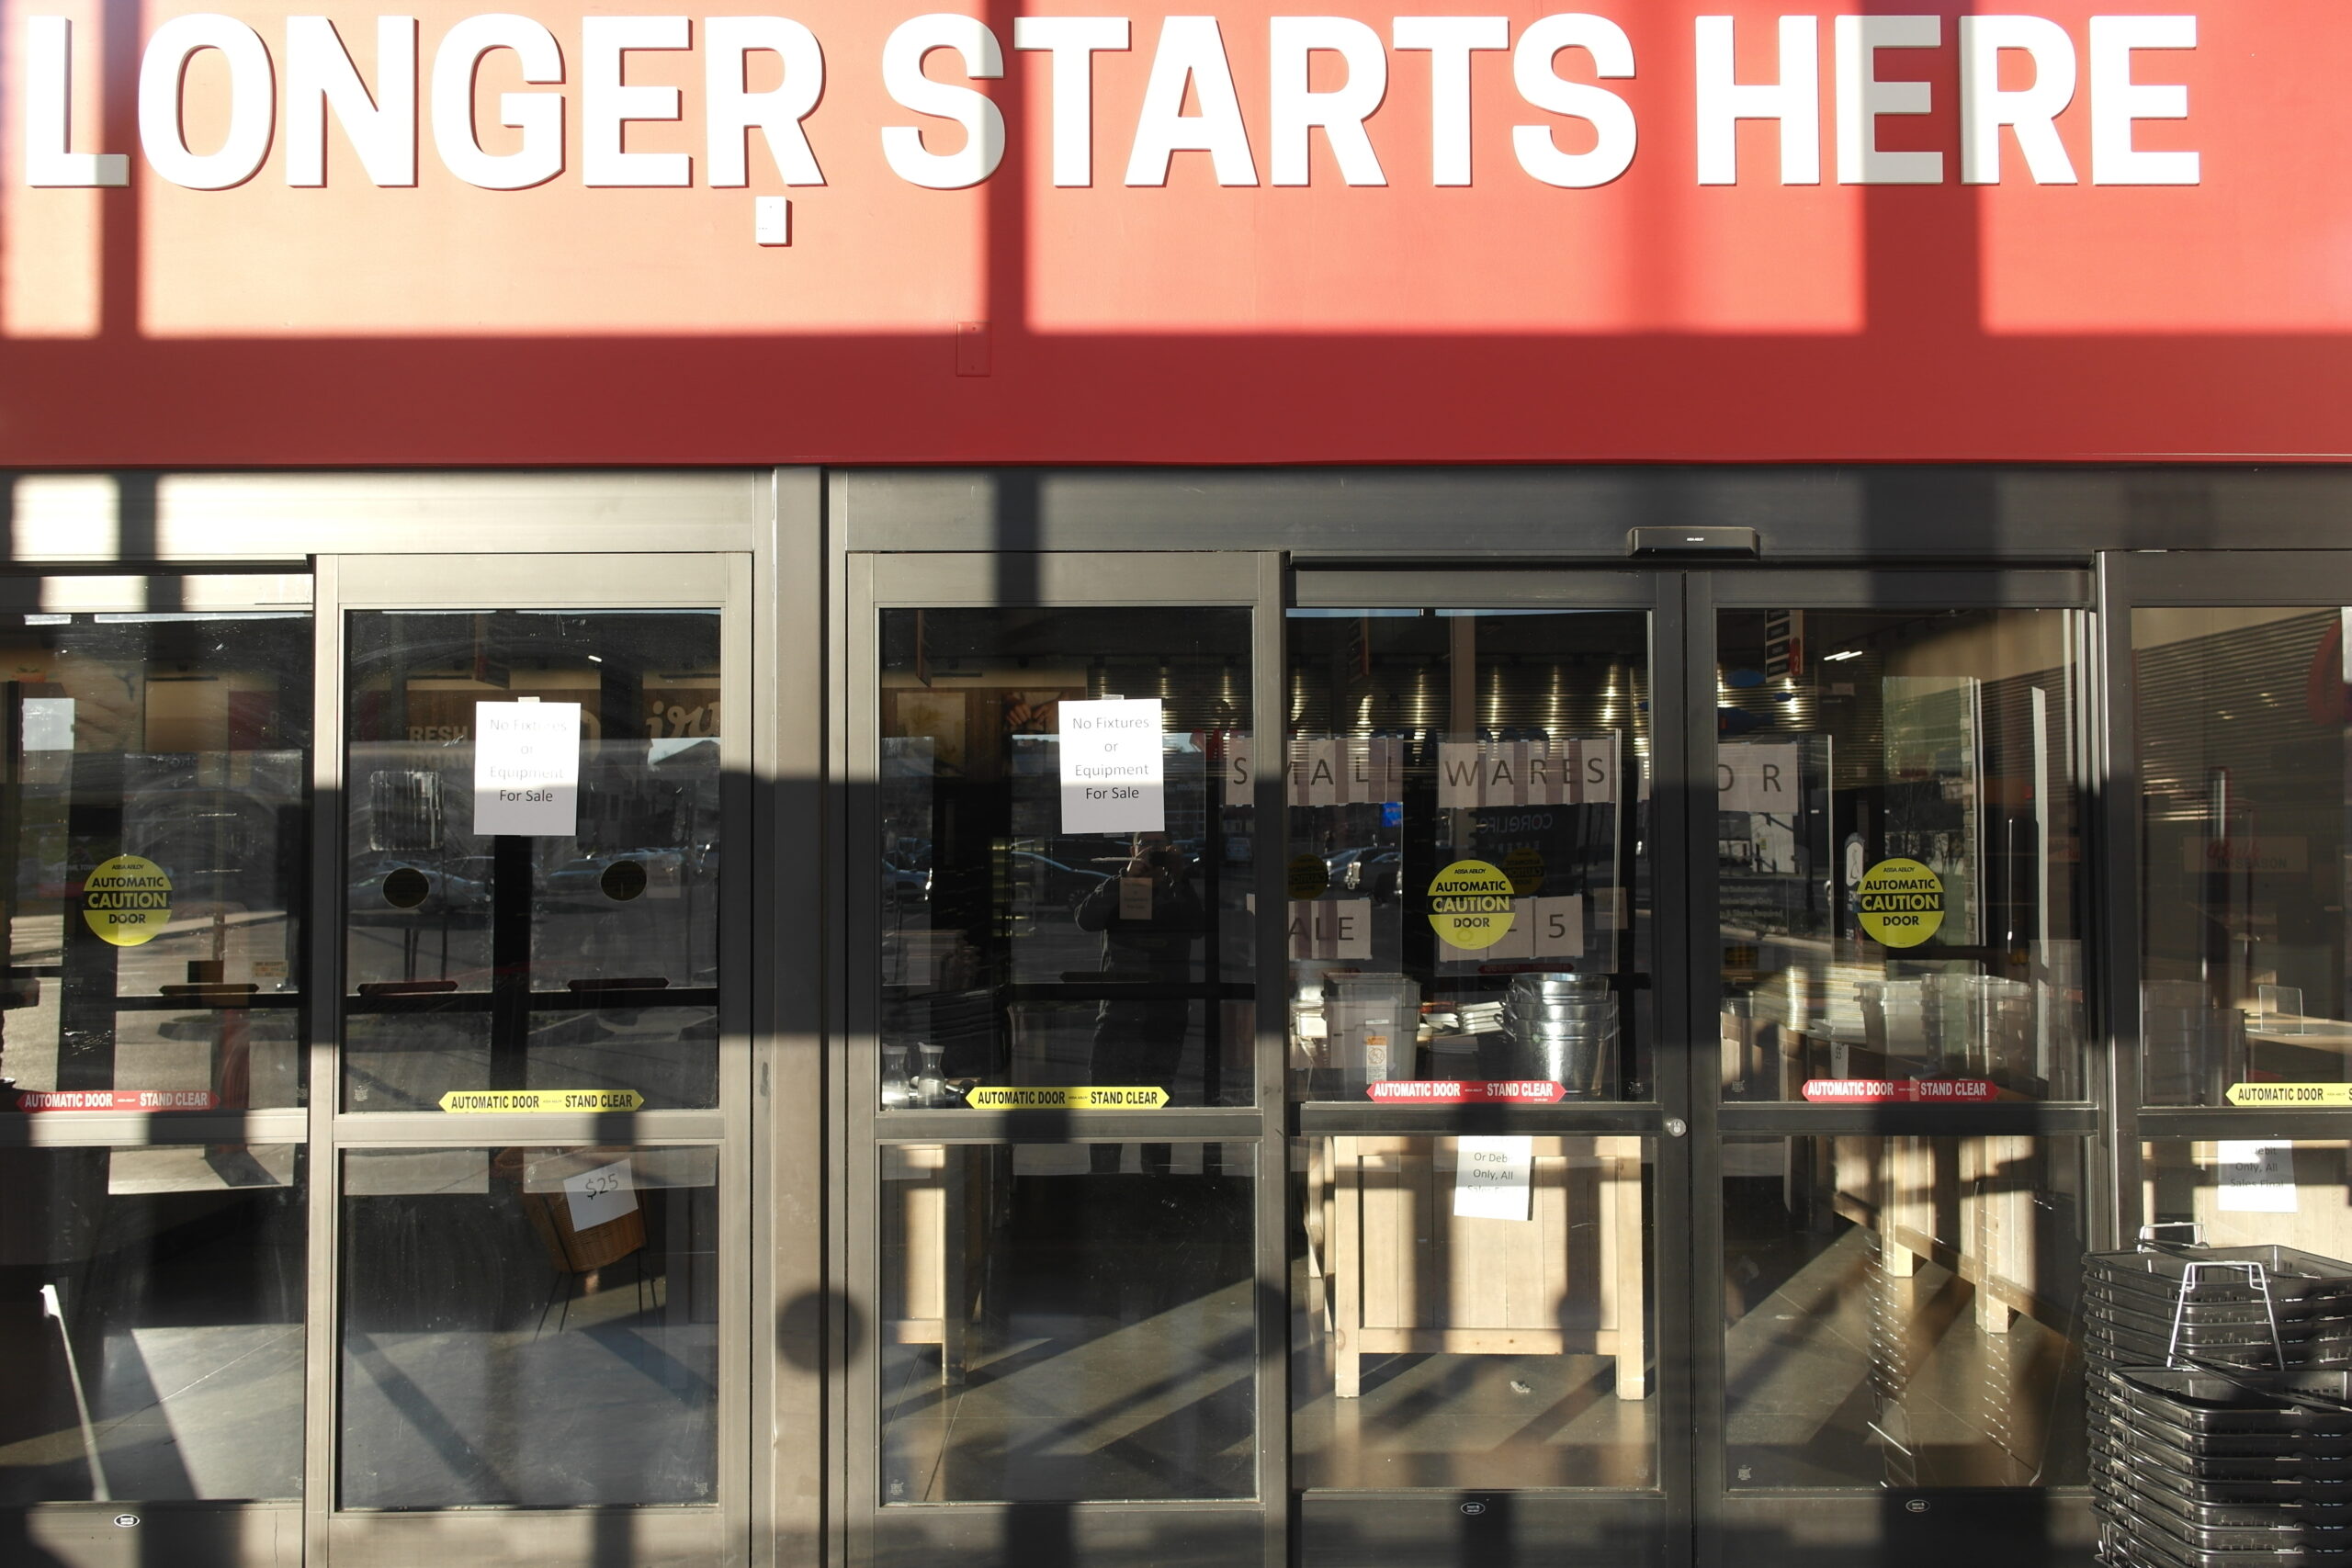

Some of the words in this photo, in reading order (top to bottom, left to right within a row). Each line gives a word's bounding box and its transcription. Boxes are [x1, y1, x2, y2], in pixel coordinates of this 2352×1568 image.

[26, 13, 828, 190] LONGER
[881, 13, 1638, 190] STARTS
[1695, 15, 2200, 186] HERE
[490, 719, 509, 731] No
[514, 719, 567, 732] Fixtes
[1072, 717, 1091, 729] No
[1096, 716, 1149, 728] Fixtures
[408, 726, 469, 743] RESH
[1104, 742, 1118, 752] or
[490, 766, 564, 781] Equipment
[1075, 764, 1149, 779] Equipment
[1444, 758, 1605, 787] WARES
[500, 790, 522, 802] For
[526, 789, 553, 802] Sale
[1086, 787, 1108, 800] For
[1112, 786, 1139, 799] Sale
[92, 877, 164, 888] AUTOMATIC
[1435, 881, 1506, 892] AUTOMATIC
[1864, 879, 1935, 891] AUTOMATIC
[87, 892, 167, 908] CAUTION
[1432, 896, 1510, 913] CAUTION
[1861, 894, 1939, 911] CAUTION
[109, 914, 146, 924] DOOR
[1453, 918, 1490, 928] DOOR
[1883, 916, 1919, 926] DOOR
[1288, 916, 1355, 942] ALE
[1548, 913, 1566, 939] 5
[1374, 1083, 1430, 1097] AUTOMATIC
[1432, 1083, 1461, 1096] DOOR
[1487, 1083, 1519, 1097] STAND
[1521, 1083, 1554, 1097] CLEAR
[1807, 1082, 1865, 1096] AUTOMATIC
[1866, 1082, 1894, 1096] DOOR
[1920, 1082, 1952, 1096] STAND
[1955, 1082, 1986, 1096] CLEAR
[2238, 1088, 2294, 1100] AUTOMATIC
[2297, 1088, 2324, 1100] DOOR
[25, 1093, 84, 1108] AUTOMATIC
[85, 1093, 113, 1107] DOOR
[140, 1092, 173, 1106] STAND
[175, 1092, 208, 1106] CLEAR
[451, 1096, 509, 1109] AUTOMATIC
[512, 1095, 539, 1109] DOOR
[565, 1094, 597, 1108] STAND
[601, 1094, 633, 1108] CLEAR
[978, 1091, 1035, 1104] AUTOMATIC
[1037, 1091, 1066, 1104] DOOR
[1091, 1091, 1123, 1104] STAND
[1127, 1091, 1158, 1104] CLEAR
[1474, 1152, 1487, 1161] Or
[1488, 1153, 1514, 1163] Deb
[1473, 1168, 1498, 1180] Only,
[1500, 1170, 1513, 1180] All
[2235, 1162, 2262, 1173] Only,
[2266, 1163, 2278, 1172] All
[585, 1173, 618, 1201] $25
[2230, 1178, 2256, 1188] Sales
